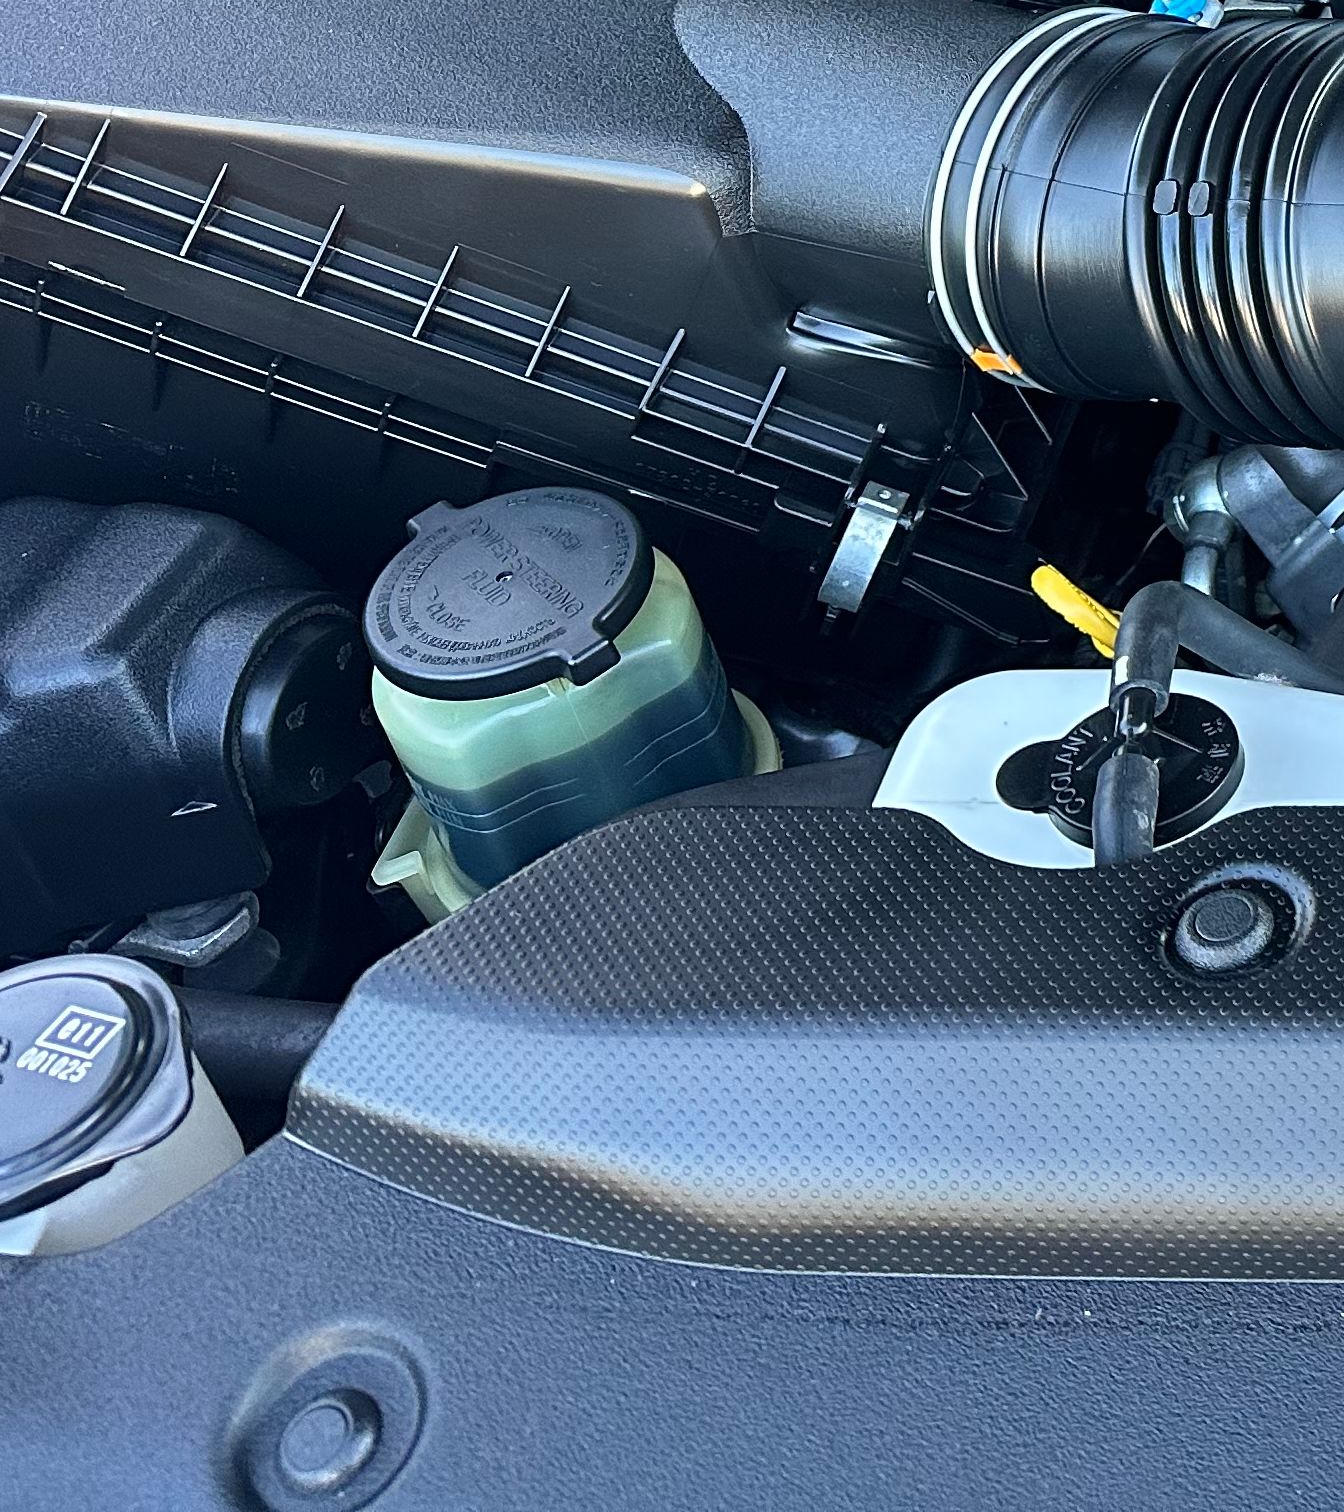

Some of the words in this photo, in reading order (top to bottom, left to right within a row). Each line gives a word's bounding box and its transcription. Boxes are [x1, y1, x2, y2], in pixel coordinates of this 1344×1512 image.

[462, 567, 512, 607] FLUID
[508, 554, 585, 620] STEERING
[426, 601, 471, 633] CLOSE
[1050, 727, 1094, 814] COOLANT
[57, 1017, 106, 1047] e11
[15, 1046, 94, 1084] 001025
